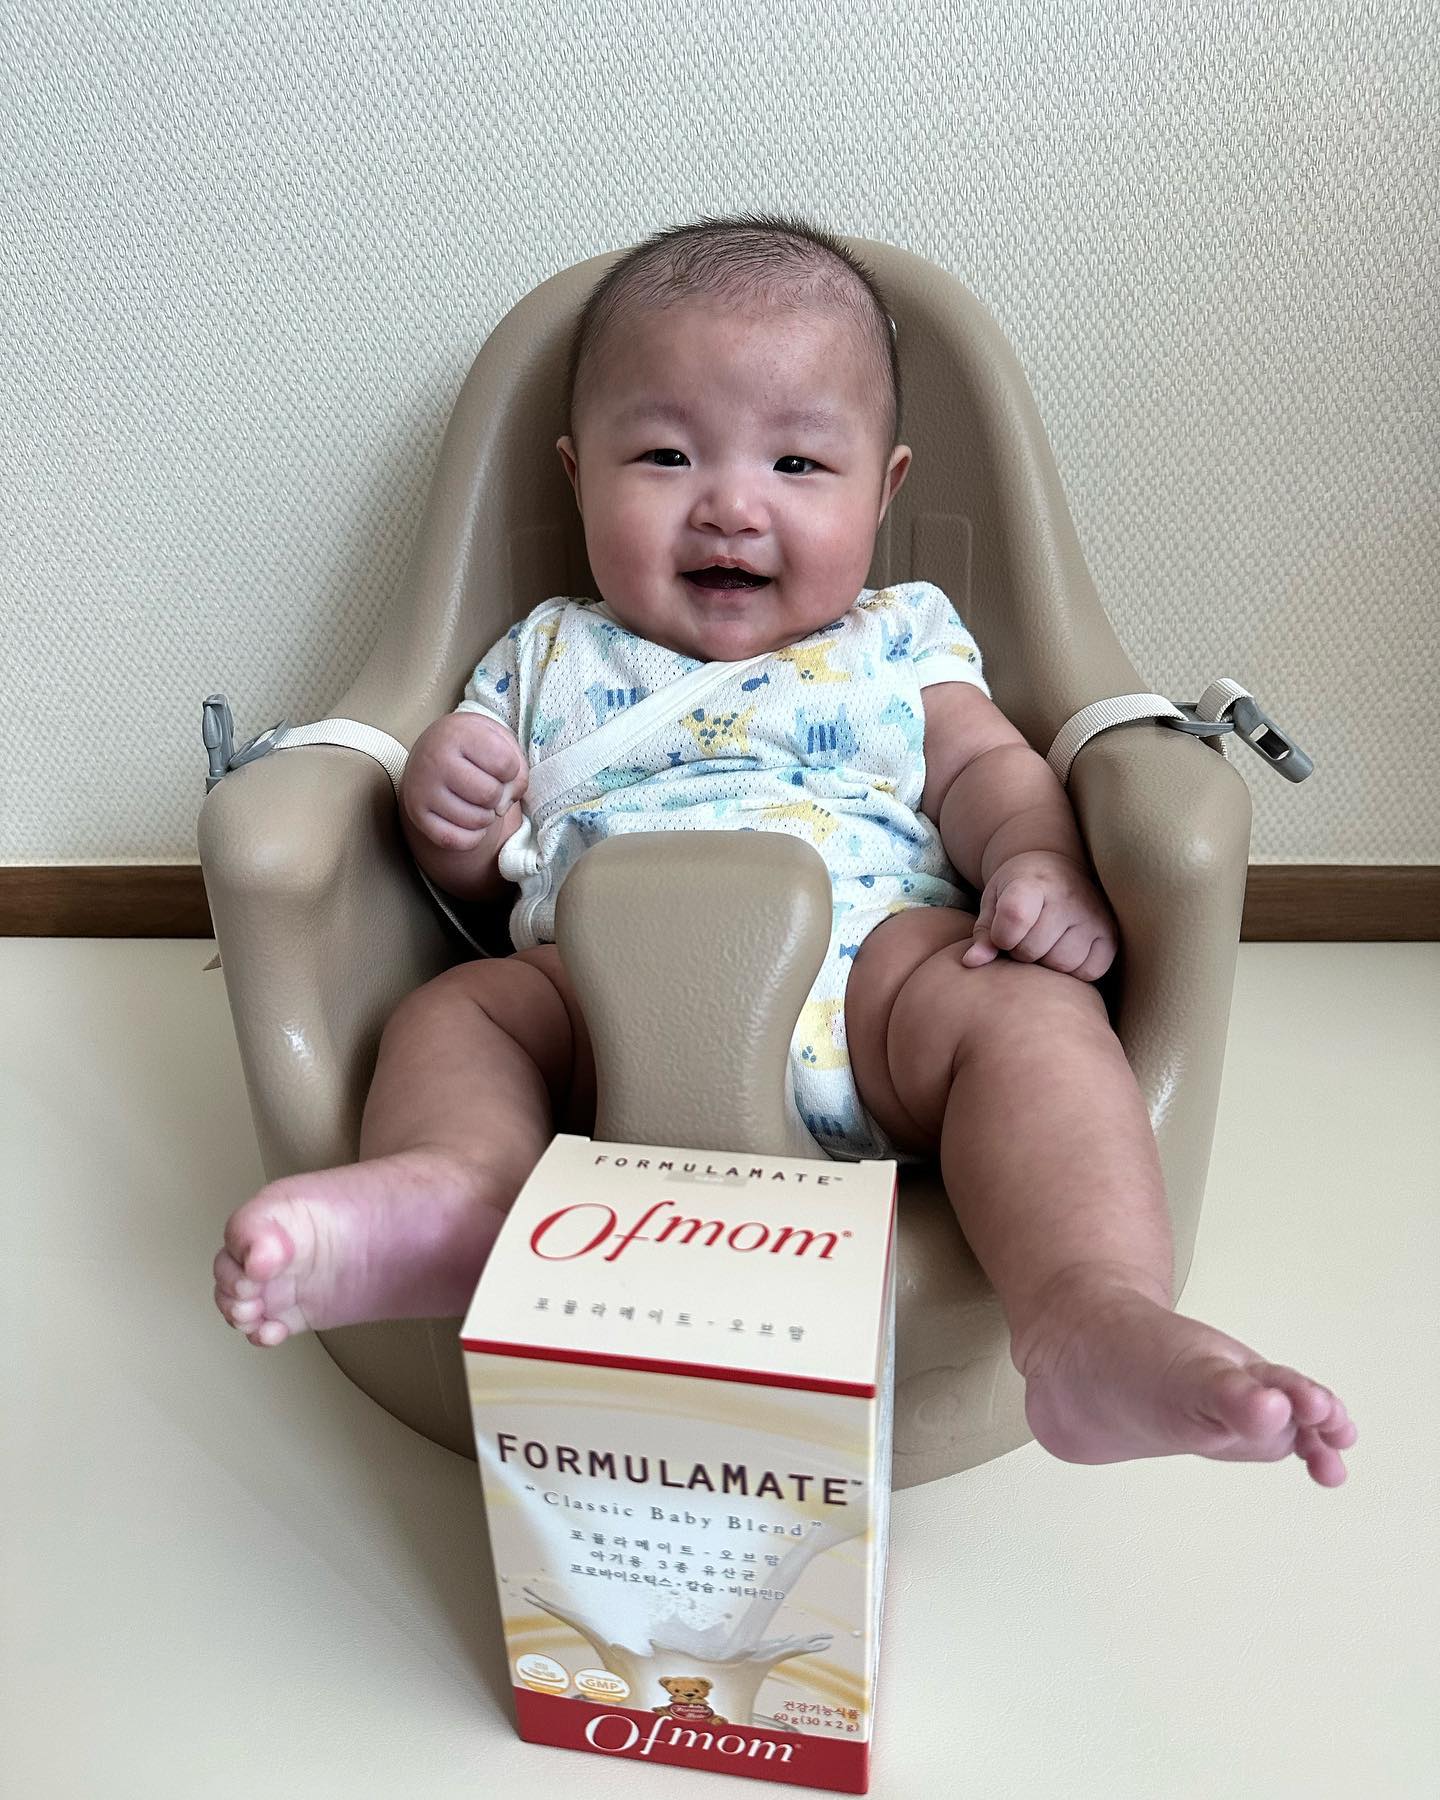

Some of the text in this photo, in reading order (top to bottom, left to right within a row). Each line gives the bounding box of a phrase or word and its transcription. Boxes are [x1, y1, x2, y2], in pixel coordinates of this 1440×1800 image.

[650, 1506, 712, 1530] Baby
[590, 1550, 642, 1568] 아기용
[702, 1564, 758, 1581] 유산균
[586, 1678, 618, 1690] GMP
[784, 1700, 860, 1720] 건강기능식품
